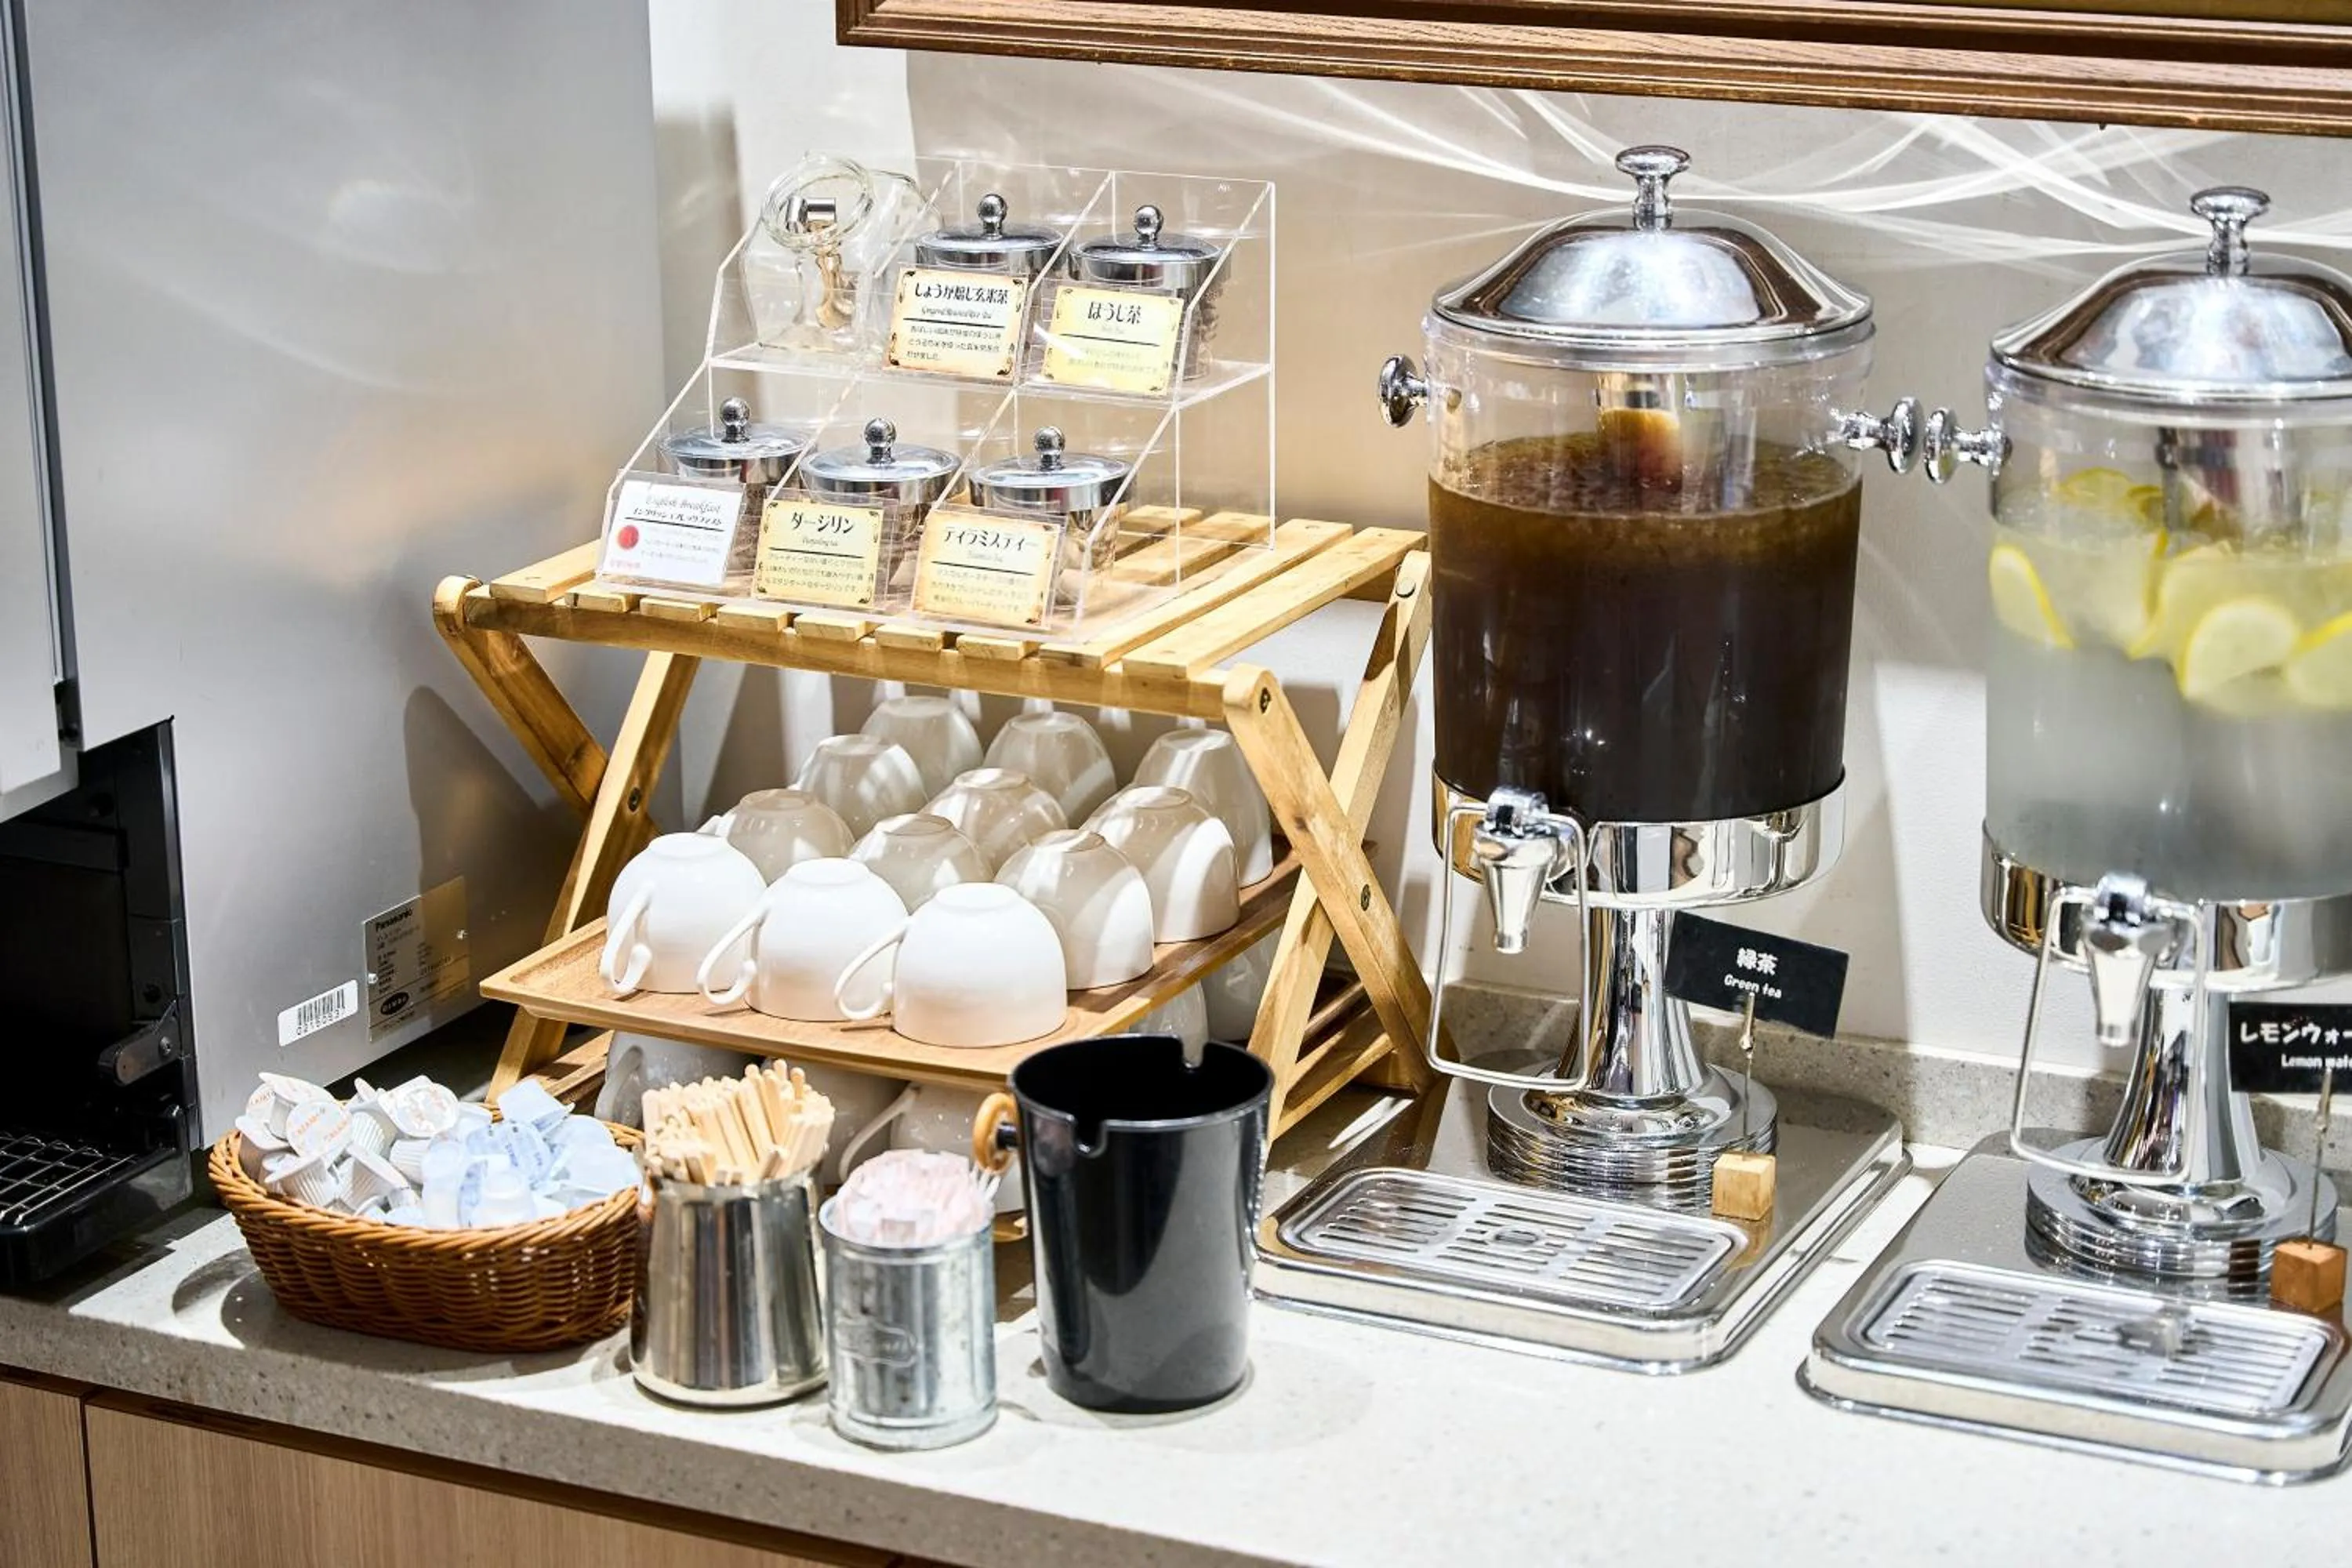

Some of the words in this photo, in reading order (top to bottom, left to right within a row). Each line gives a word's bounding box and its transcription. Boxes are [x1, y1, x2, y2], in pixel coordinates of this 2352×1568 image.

[1087, 300, 1142, 325] ほうじ茶
[790, 511, 855, 534] ダージリン
[943, 525, 1040, 551] ティラミスティー
[1736, 947, 1779, 976] 緑茶
[1724, 974, 1760, 993] Green
[1762, 982, 1782, 999] tea
[2281, 1053, 2323, 1069] Lemon
